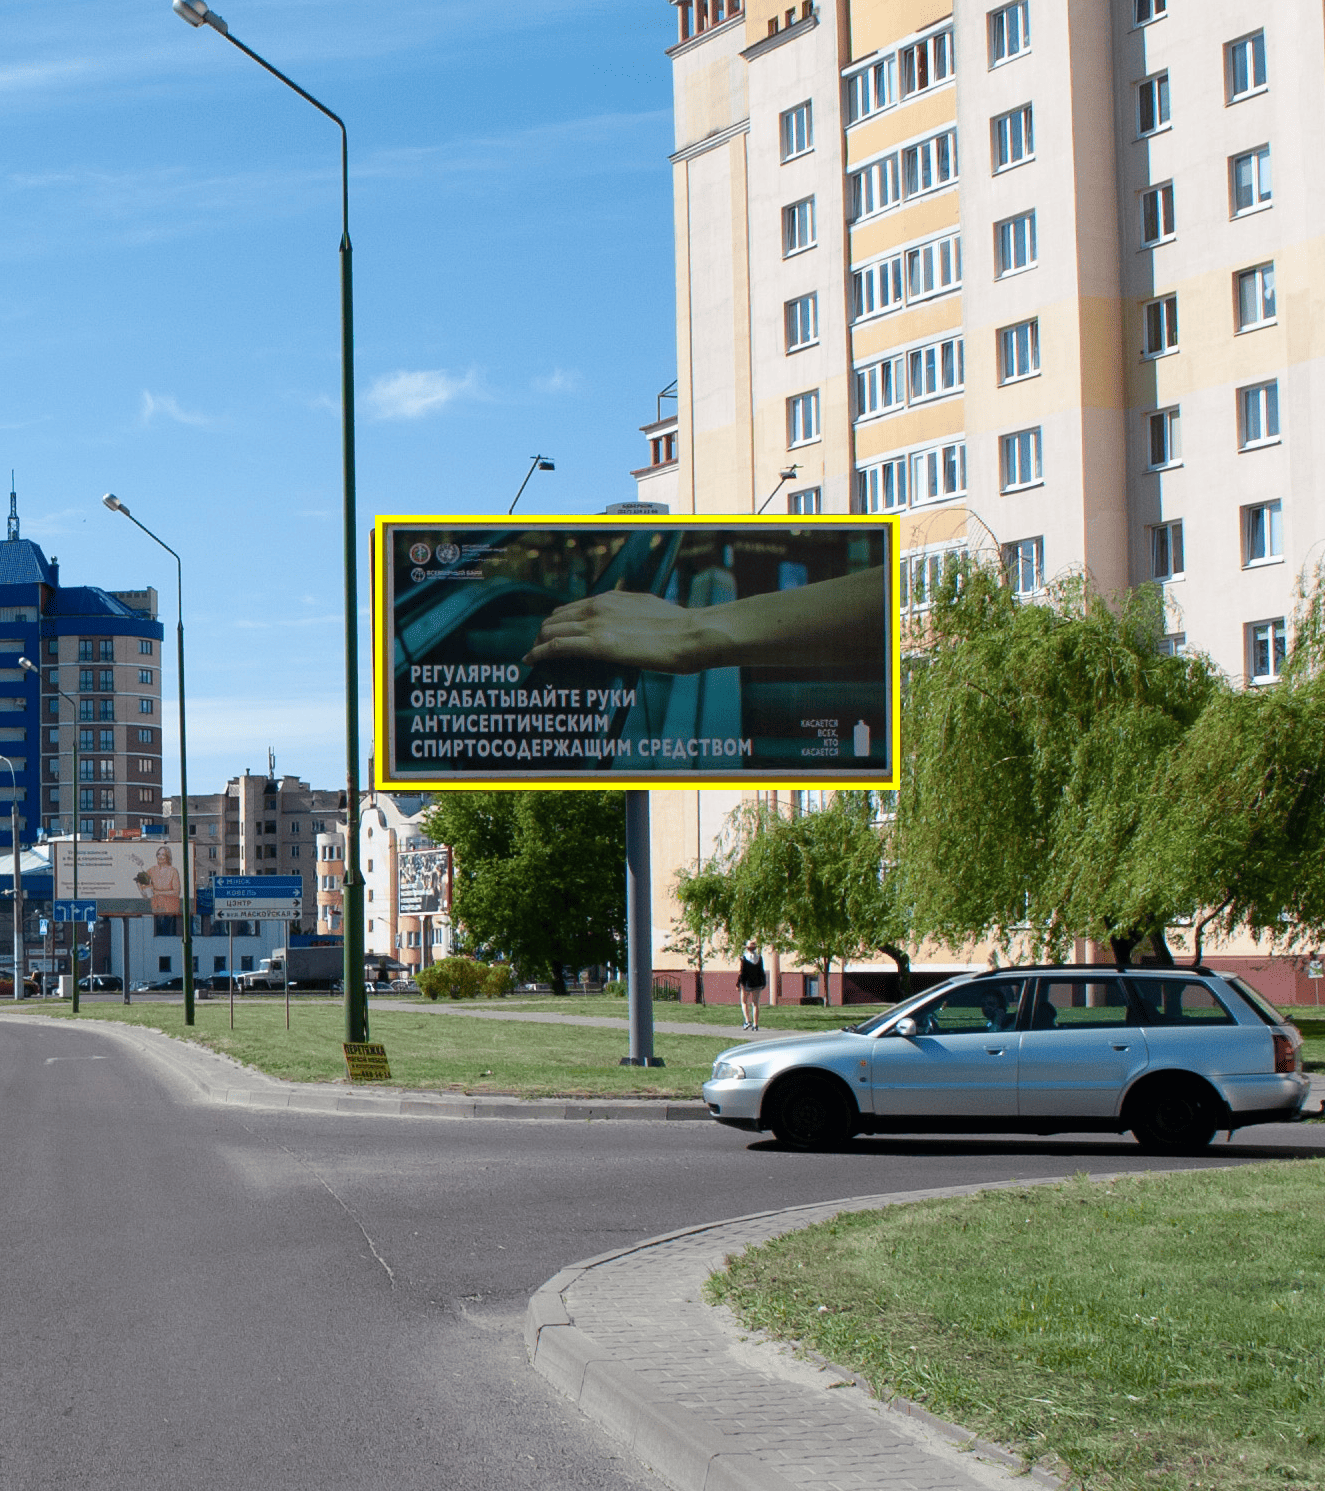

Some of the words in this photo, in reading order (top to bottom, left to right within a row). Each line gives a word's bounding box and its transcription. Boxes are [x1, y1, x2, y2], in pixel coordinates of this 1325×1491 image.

[411, 665, 520, 686] РЕГУЛЯРНО
[410, 684, 580, 708] ОБРАБАТЫВАЙТЕ
[586, 689, 637, 711] РУКИ
[410, 714, 609, 733] АНТИСЕПТИЧЕСКИМ
[800, 719, 839, 728] КАСАЕТСЯ
[817, 729, 839, 738] ВСЕХ,
[411, 738, 632, 760] СПИРТОСОДЕРЖАЩИМ
[637, 738, 754, 760] СРЕДСТВОМ
[823, 738, 839, 747] КТО
[800, 748, 839, 757] КАСАЕТСЯ
